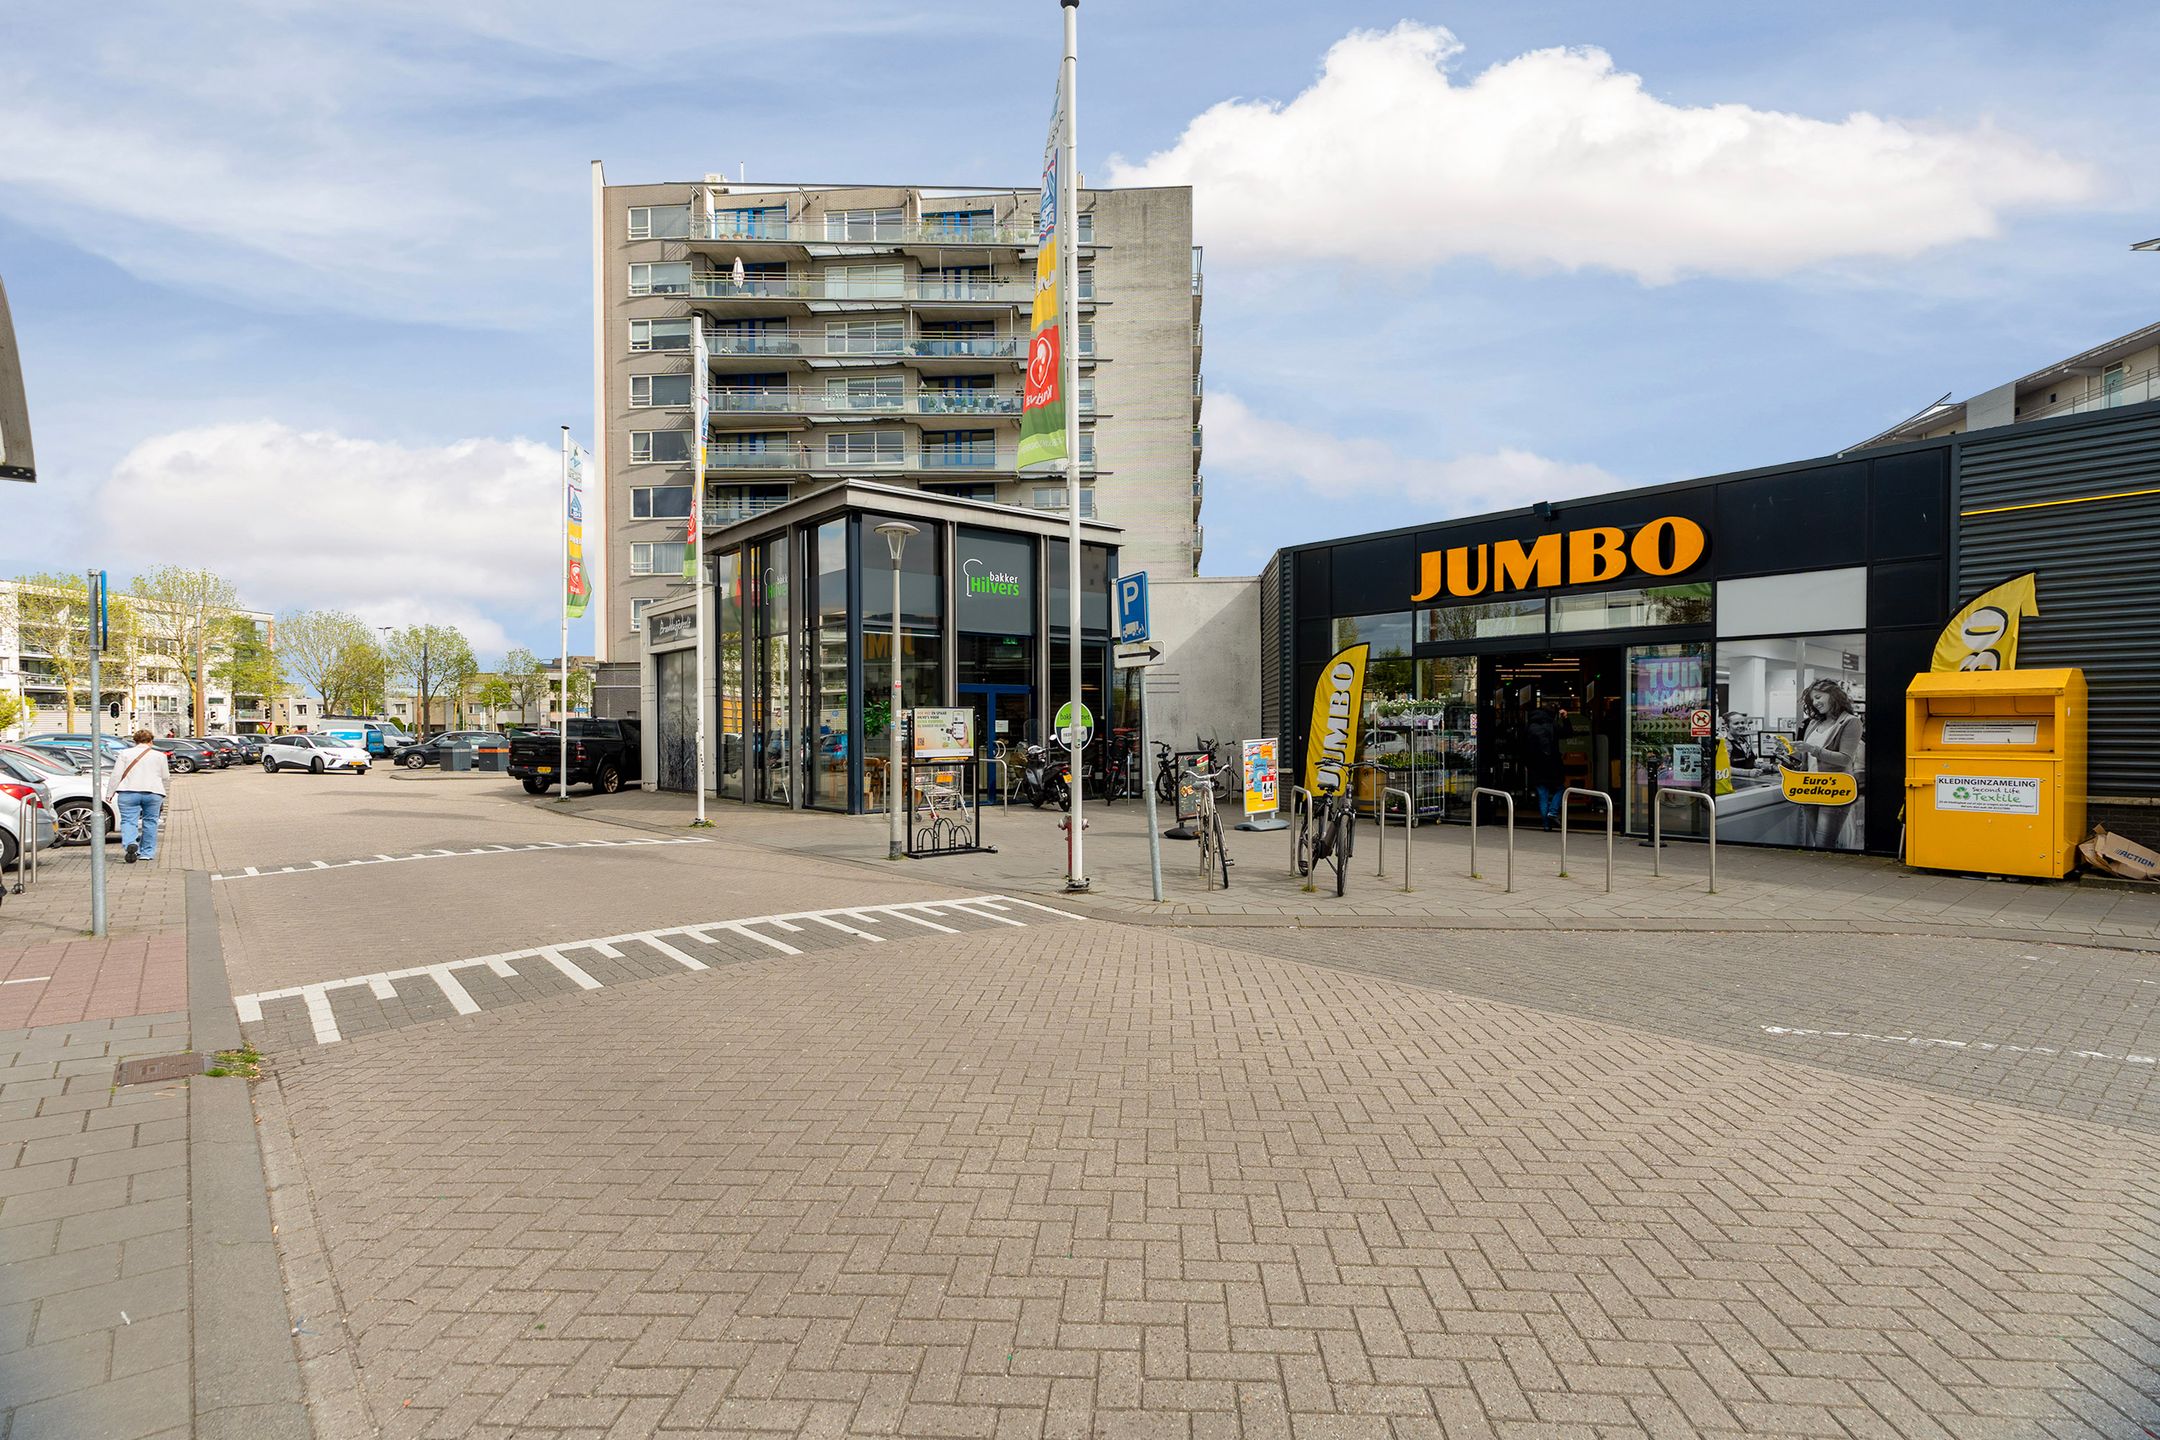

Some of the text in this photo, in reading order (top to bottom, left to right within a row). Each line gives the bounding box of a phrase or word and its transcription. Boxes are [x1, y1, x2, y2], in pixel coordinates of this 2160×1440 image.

[1411, 515, 1705, 602] JUMBO
[989, 571, 1018, 583] bakker
[971, 576, 1020, 597] Hilvers
[1122, 581, 1139, 616] P
[1316, 661, 1355, 788] JUMBO
[1802, 776, 1837, 786] Euro's
[1938, 777, 2036, 788] KLEDINGINZAMELING
[1789, 786, 1851, 798] goedkoper
[2004, 787, 2020, 795] Life
[1972, 792, 2020, 803] Textile
[2119, 850, 2155, 868] ACTION
